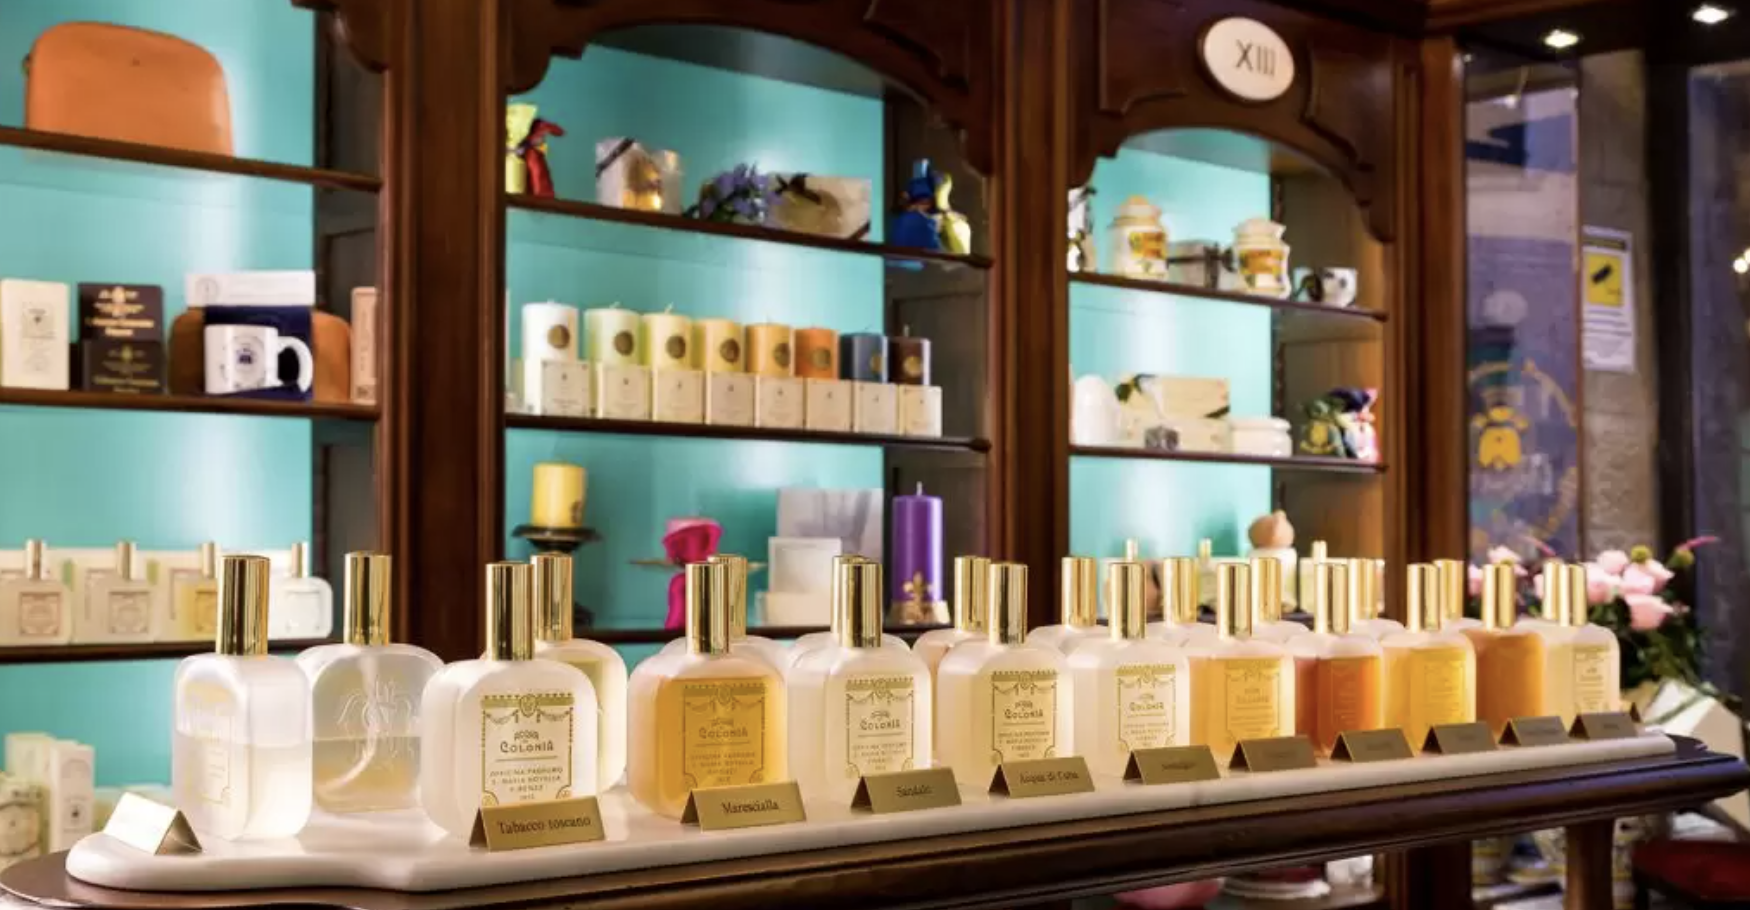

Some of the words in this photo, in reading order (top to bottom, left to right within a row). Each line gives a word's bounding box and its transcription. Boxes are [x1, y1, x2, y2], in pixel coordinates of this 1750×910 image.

[1235, 38, 1276, 77] XIII
[699, 726, 748, 739] COLONIA
[500, 740, 554, 753] COLONIA
[720, 798, 780, 814] Marescialla
[497, 819, 545, 834] Tabacco
[548, 817, 591, 830] toscano
